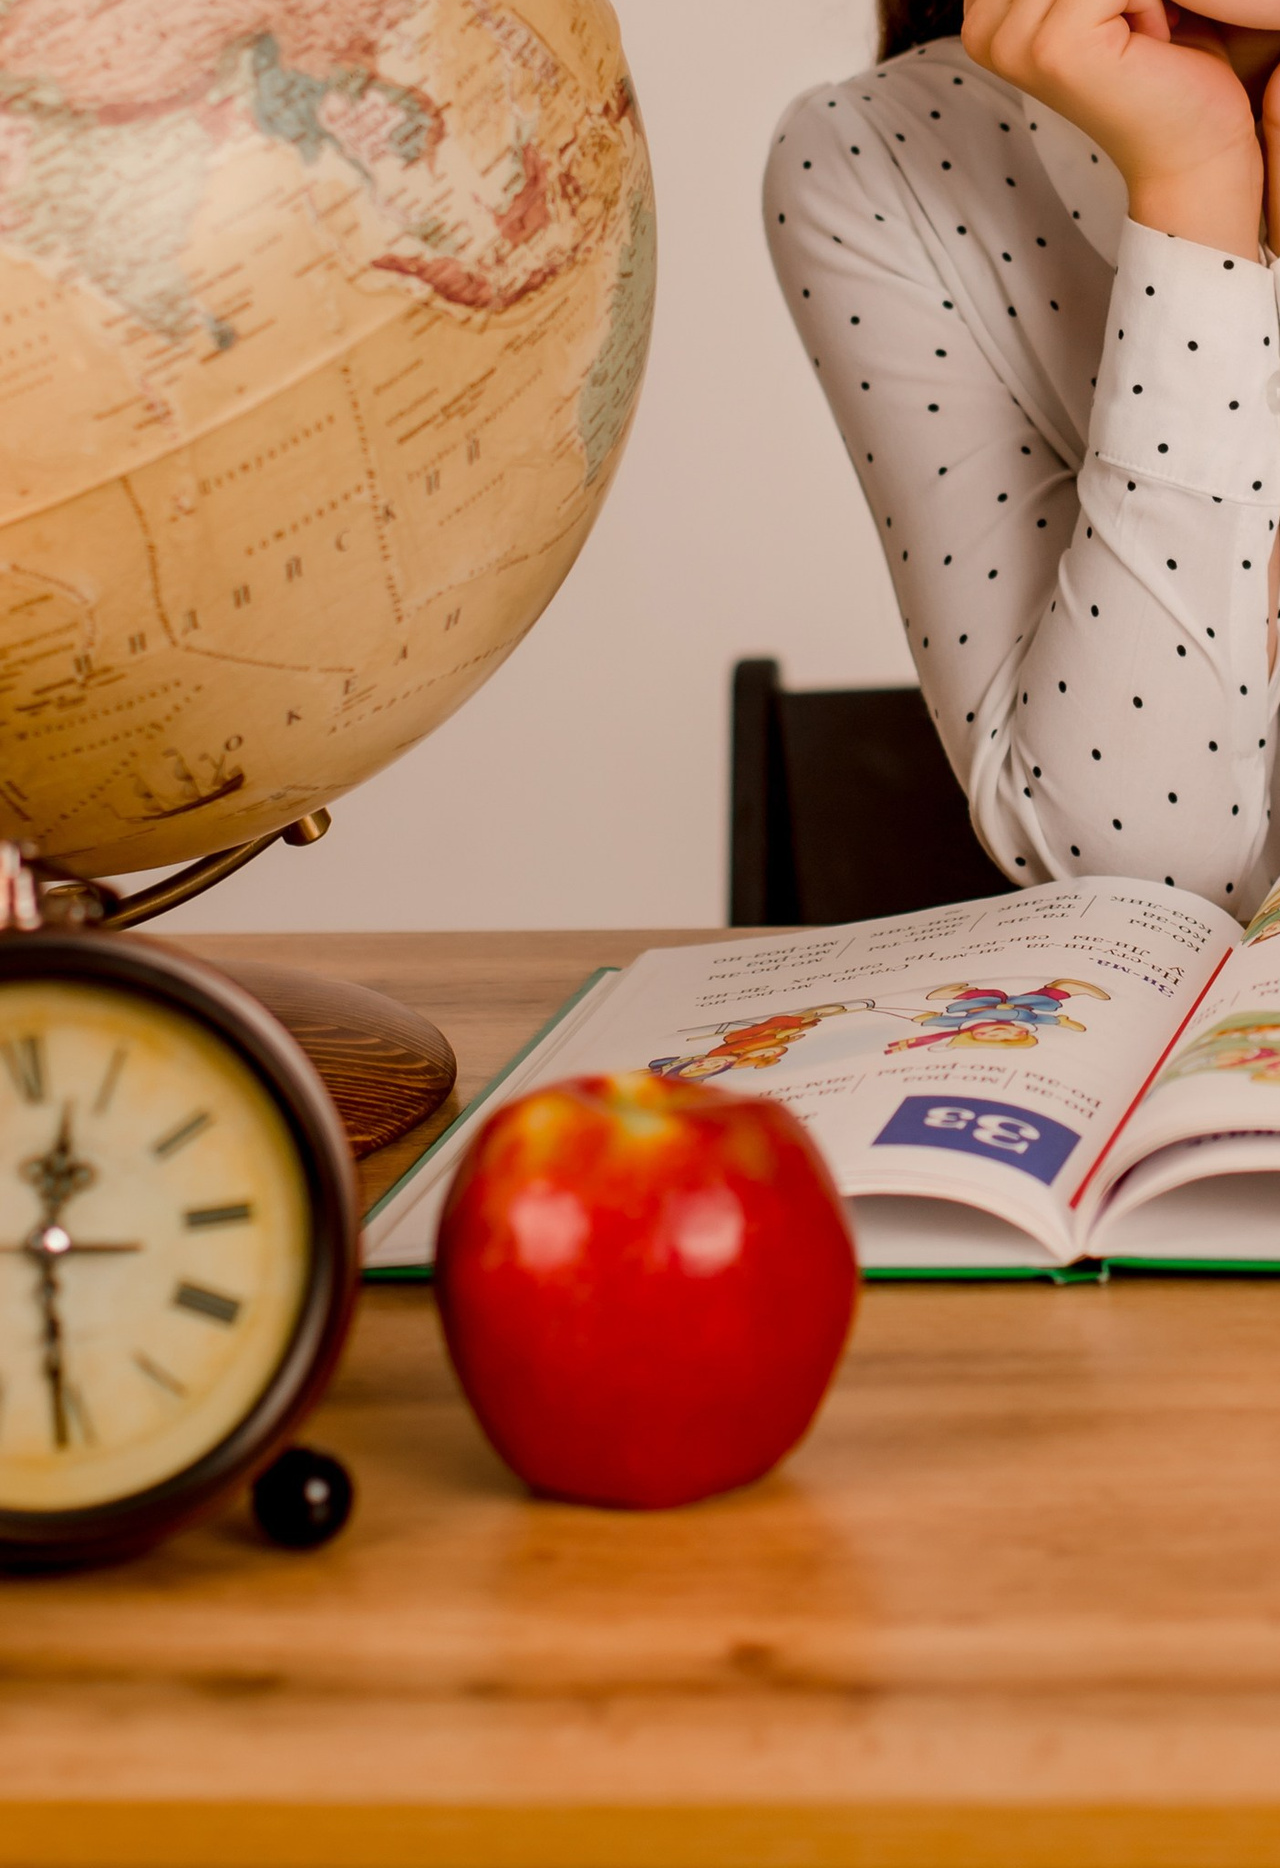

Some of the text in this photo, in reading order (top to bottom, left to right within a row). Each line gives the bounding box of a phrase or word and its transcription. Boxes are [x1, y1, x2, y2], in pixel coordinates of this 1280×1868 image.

[1110, 896, 1213, 934] коз-лик
[1142, 911, 1208, 944] ко-за
[1127, 918, 1202, 954] ко-зы
[1026, 943, 1181, 986] На-сту-пи-ла
[1088, 958, 1175, 998] Зи-ма.
